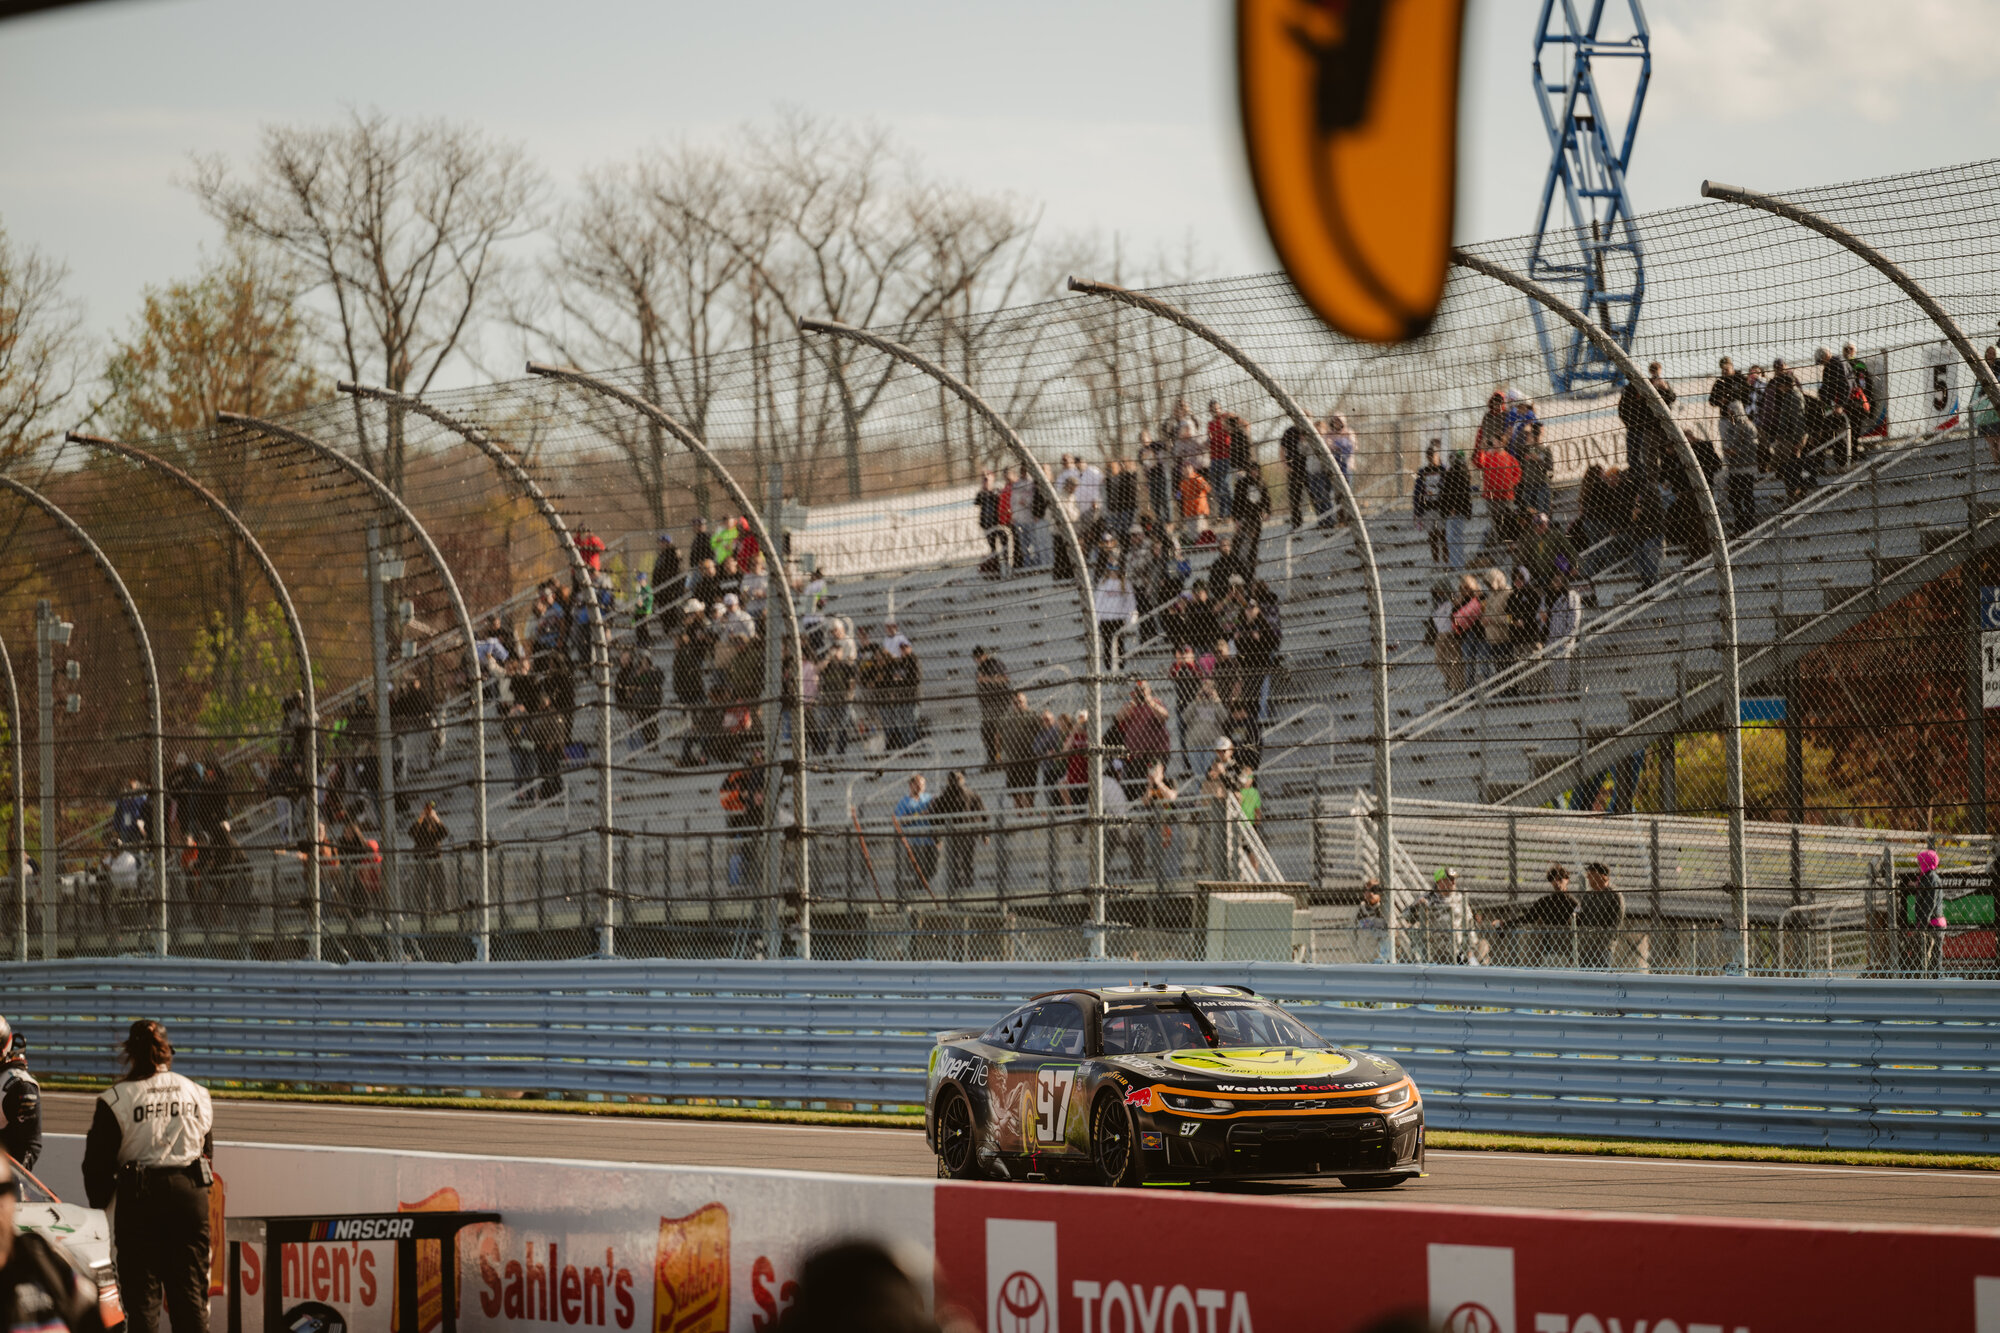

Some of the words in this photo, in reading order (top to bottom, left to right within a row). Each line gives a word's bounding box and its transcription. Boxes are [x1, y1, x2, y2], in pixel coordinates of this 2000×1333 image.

[1933, 366, 1948, 411] 5
[1942, 878, 1963, 887] NTRY
[1965, 877, 1993, 887] POLICY
[937, 1048, 989, 1087] SuperFile
[133, 1101, 199, 1123] OFFICIAL
[1037, 1069, 1075, 1142] 97
[1180, 1122, 1200, 1136] 97
[334, 1218, 414, 1240] NASCAR
[479, 1236, 635, 1330] Sahlen's
[1073, 1279, 1254, 1333] TOYOTA
